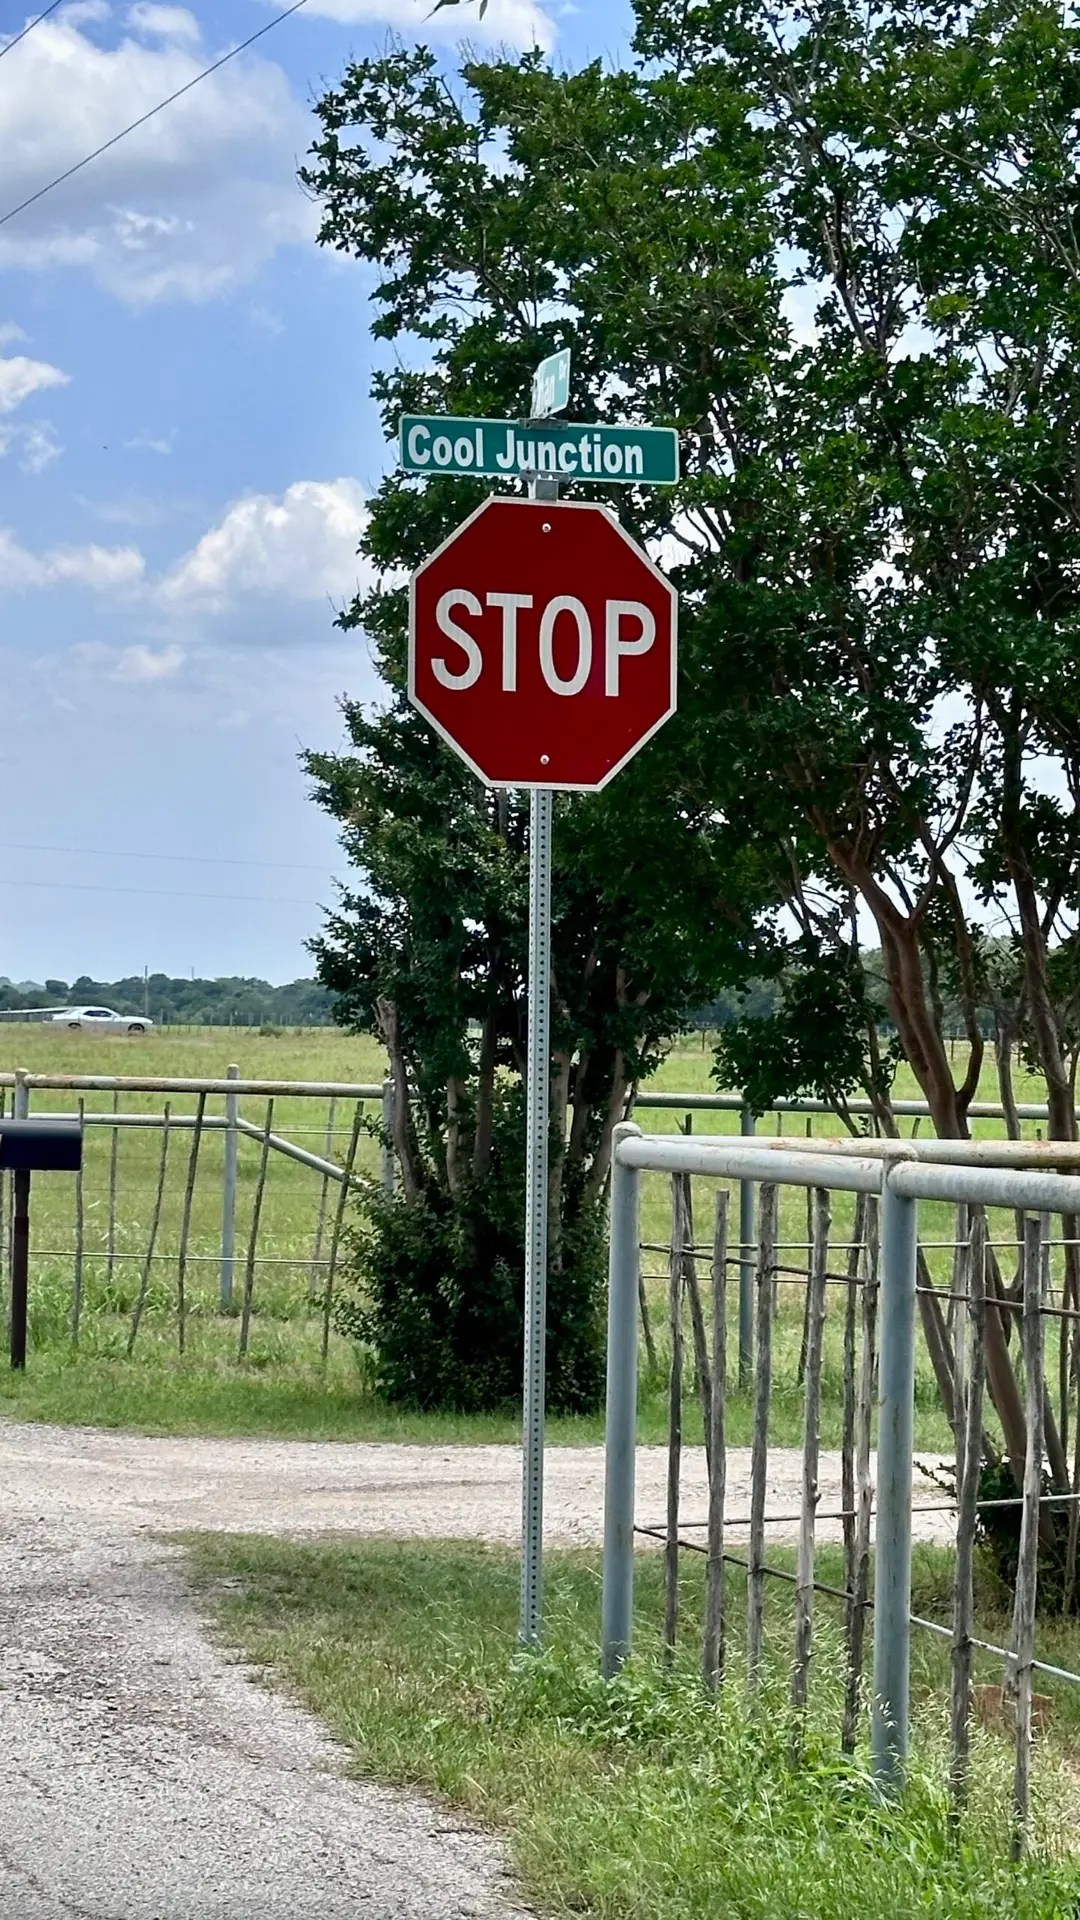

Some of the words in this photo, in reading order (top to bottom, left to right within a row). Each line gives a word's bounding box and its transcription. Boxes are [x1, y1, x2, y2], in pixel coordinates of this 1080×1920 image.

[407, 424, 483, 467] Cool
[496, 429, 644, 475] Junction
[431, 589, 656, 697] STOP
